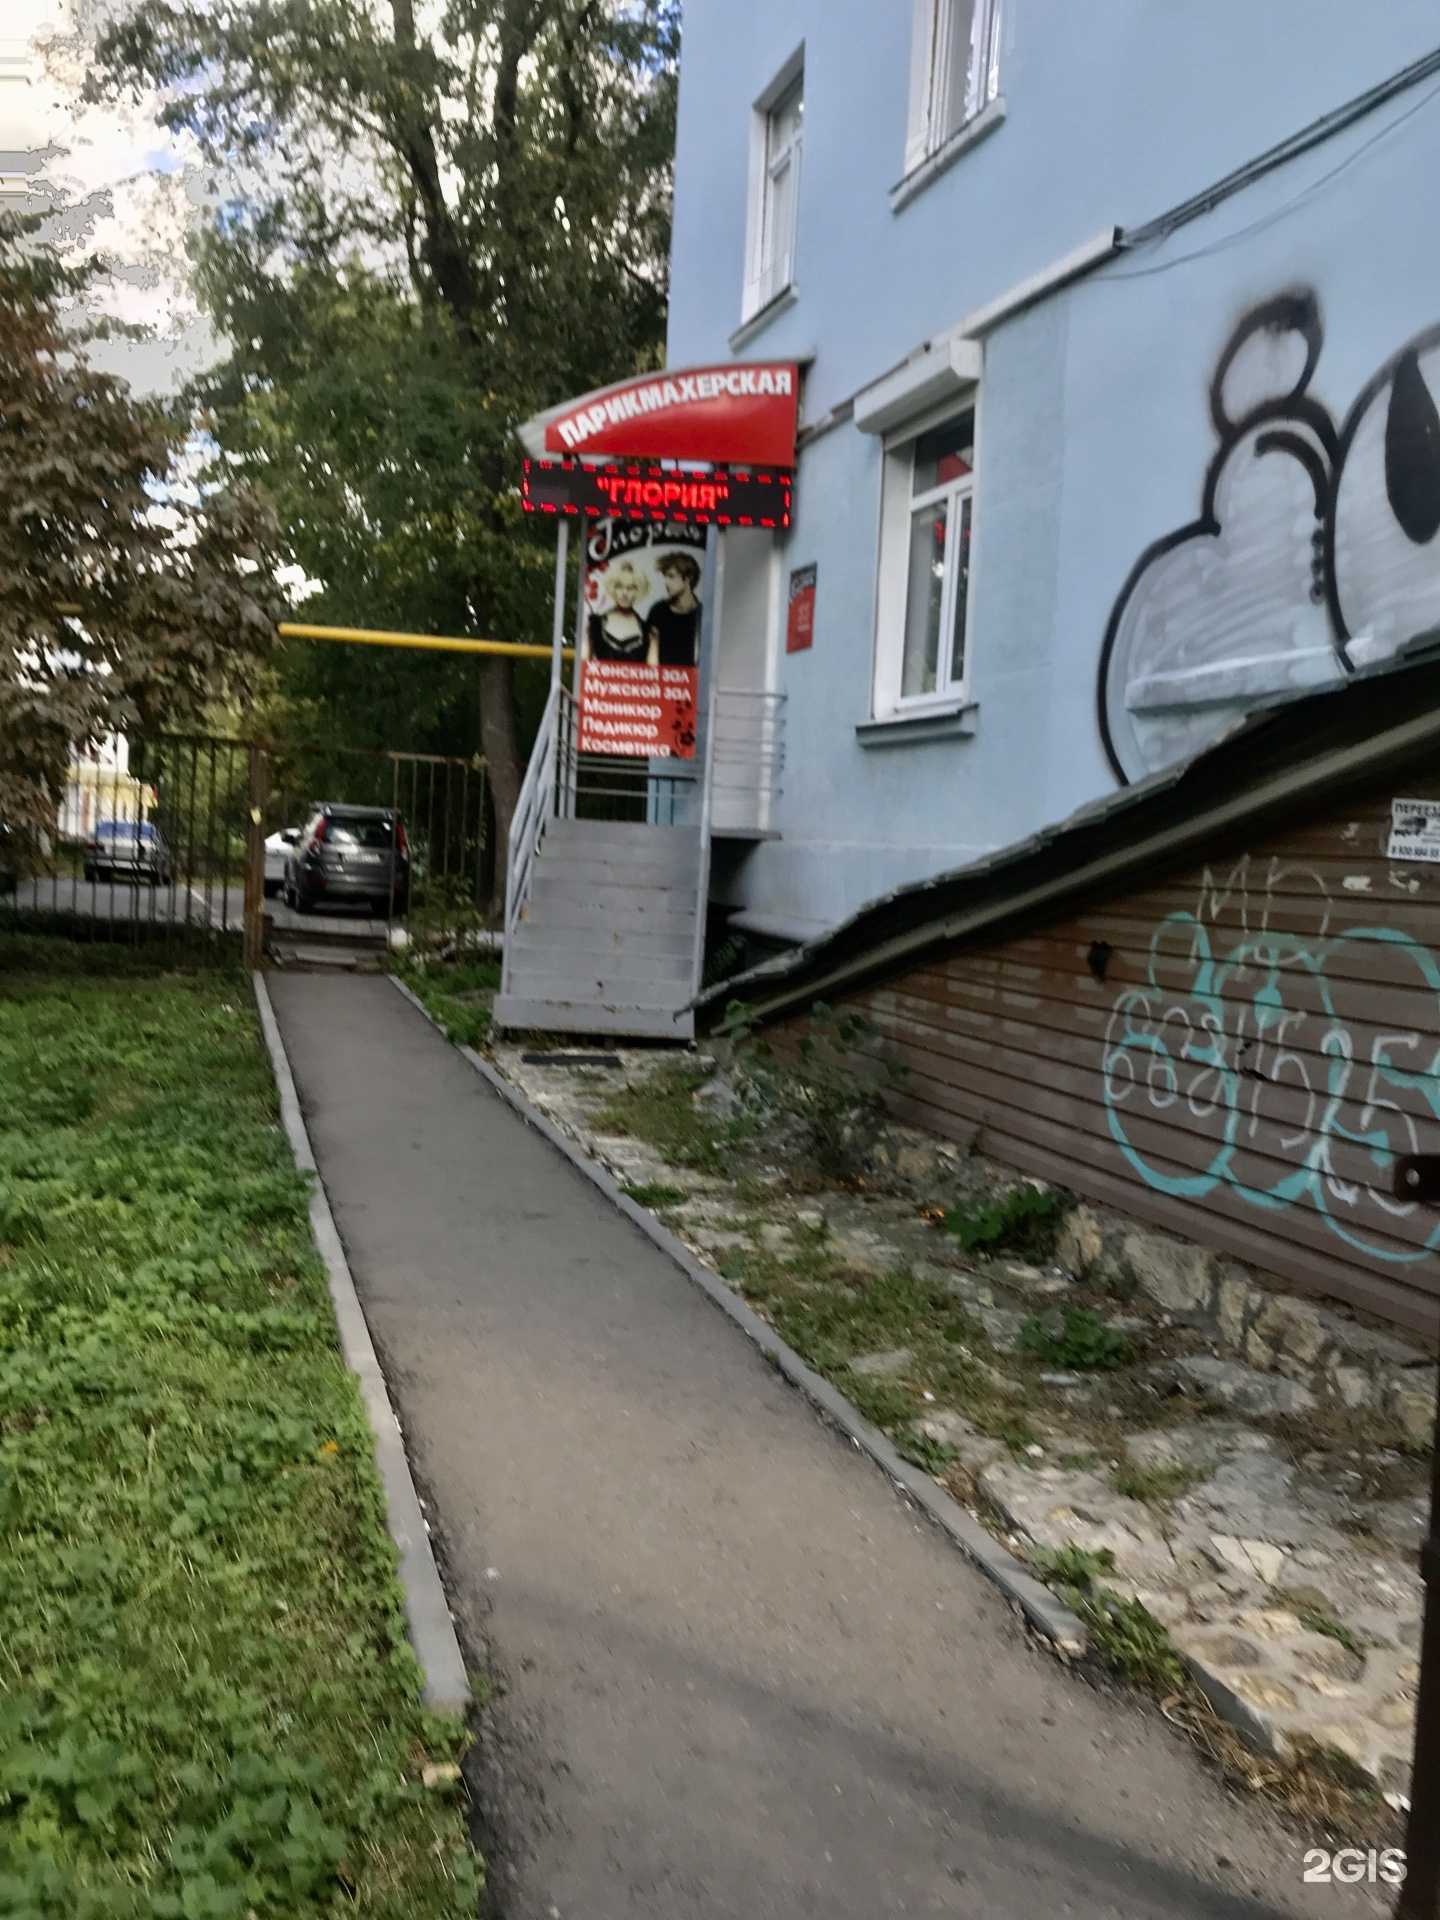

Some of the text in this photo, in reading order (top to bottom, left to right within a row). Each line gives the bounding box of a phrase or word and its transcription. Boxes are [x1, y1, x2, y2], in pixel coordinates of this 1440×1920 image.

[557, 370, 792, 448] ПАРИКМАХЕРСКАЯ
[586, 659, 659, 681] Женский
[584, 678, 662, 698] Мужской
[582, 715, 659, 739] Педикюр
